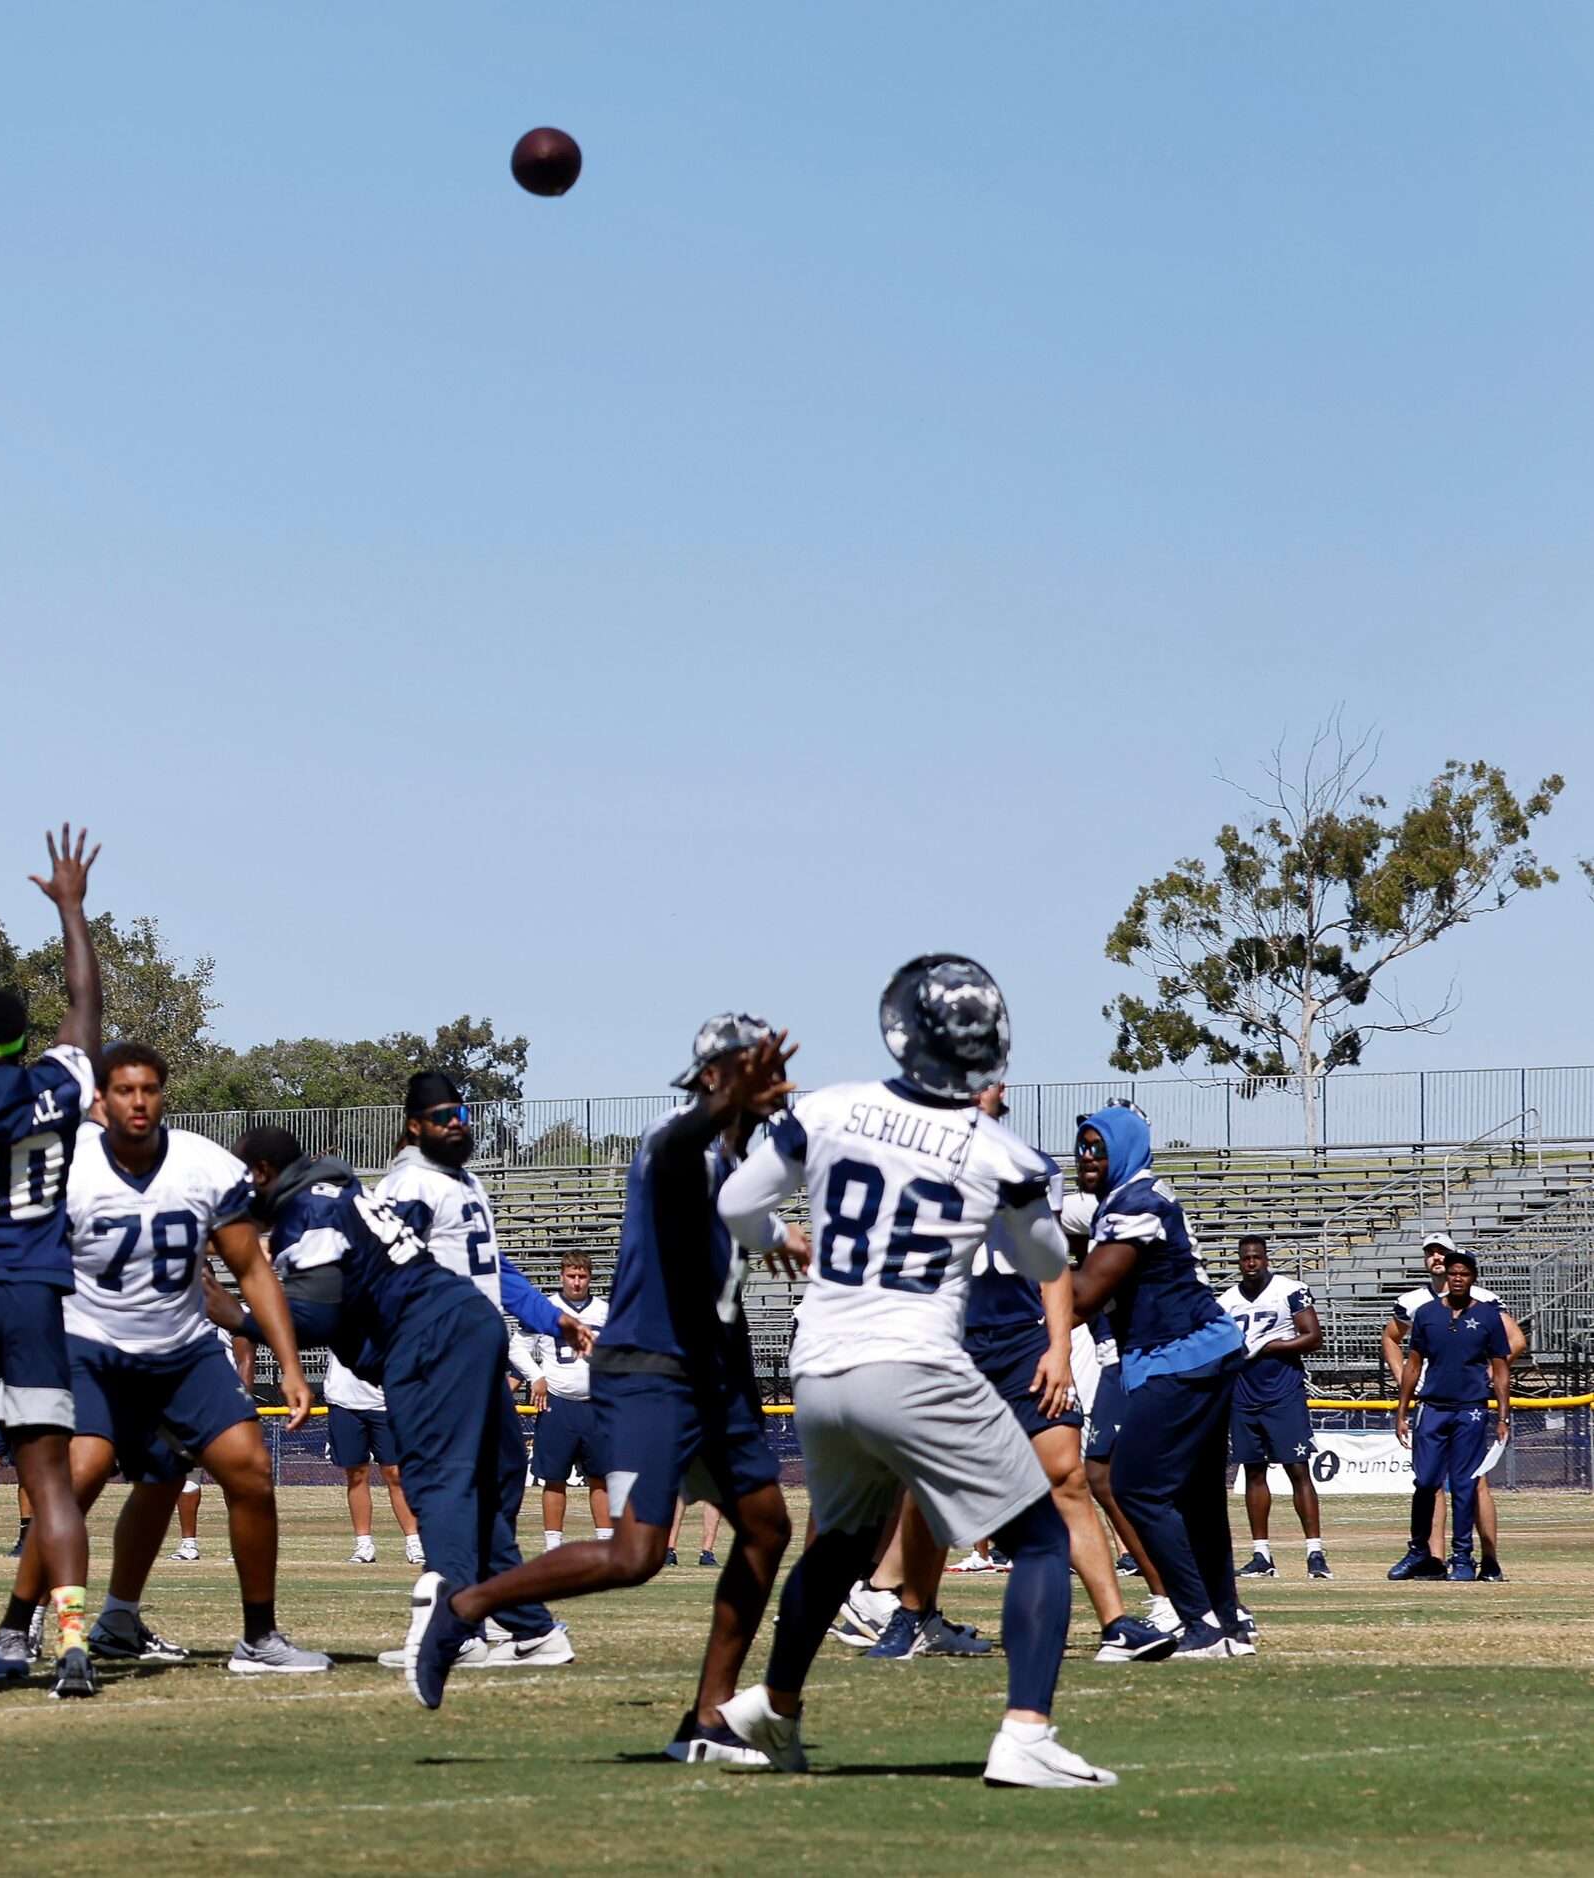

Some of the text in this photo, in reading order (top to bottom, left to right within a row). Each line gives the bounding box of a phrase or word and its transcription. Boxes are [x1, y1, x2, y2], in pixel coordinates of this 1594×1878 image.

[844, 1103, 973, 1165] SCHULTZ
[93, 1210, 199, 1293] 78
[819, 1158, 964, 1294] 86
